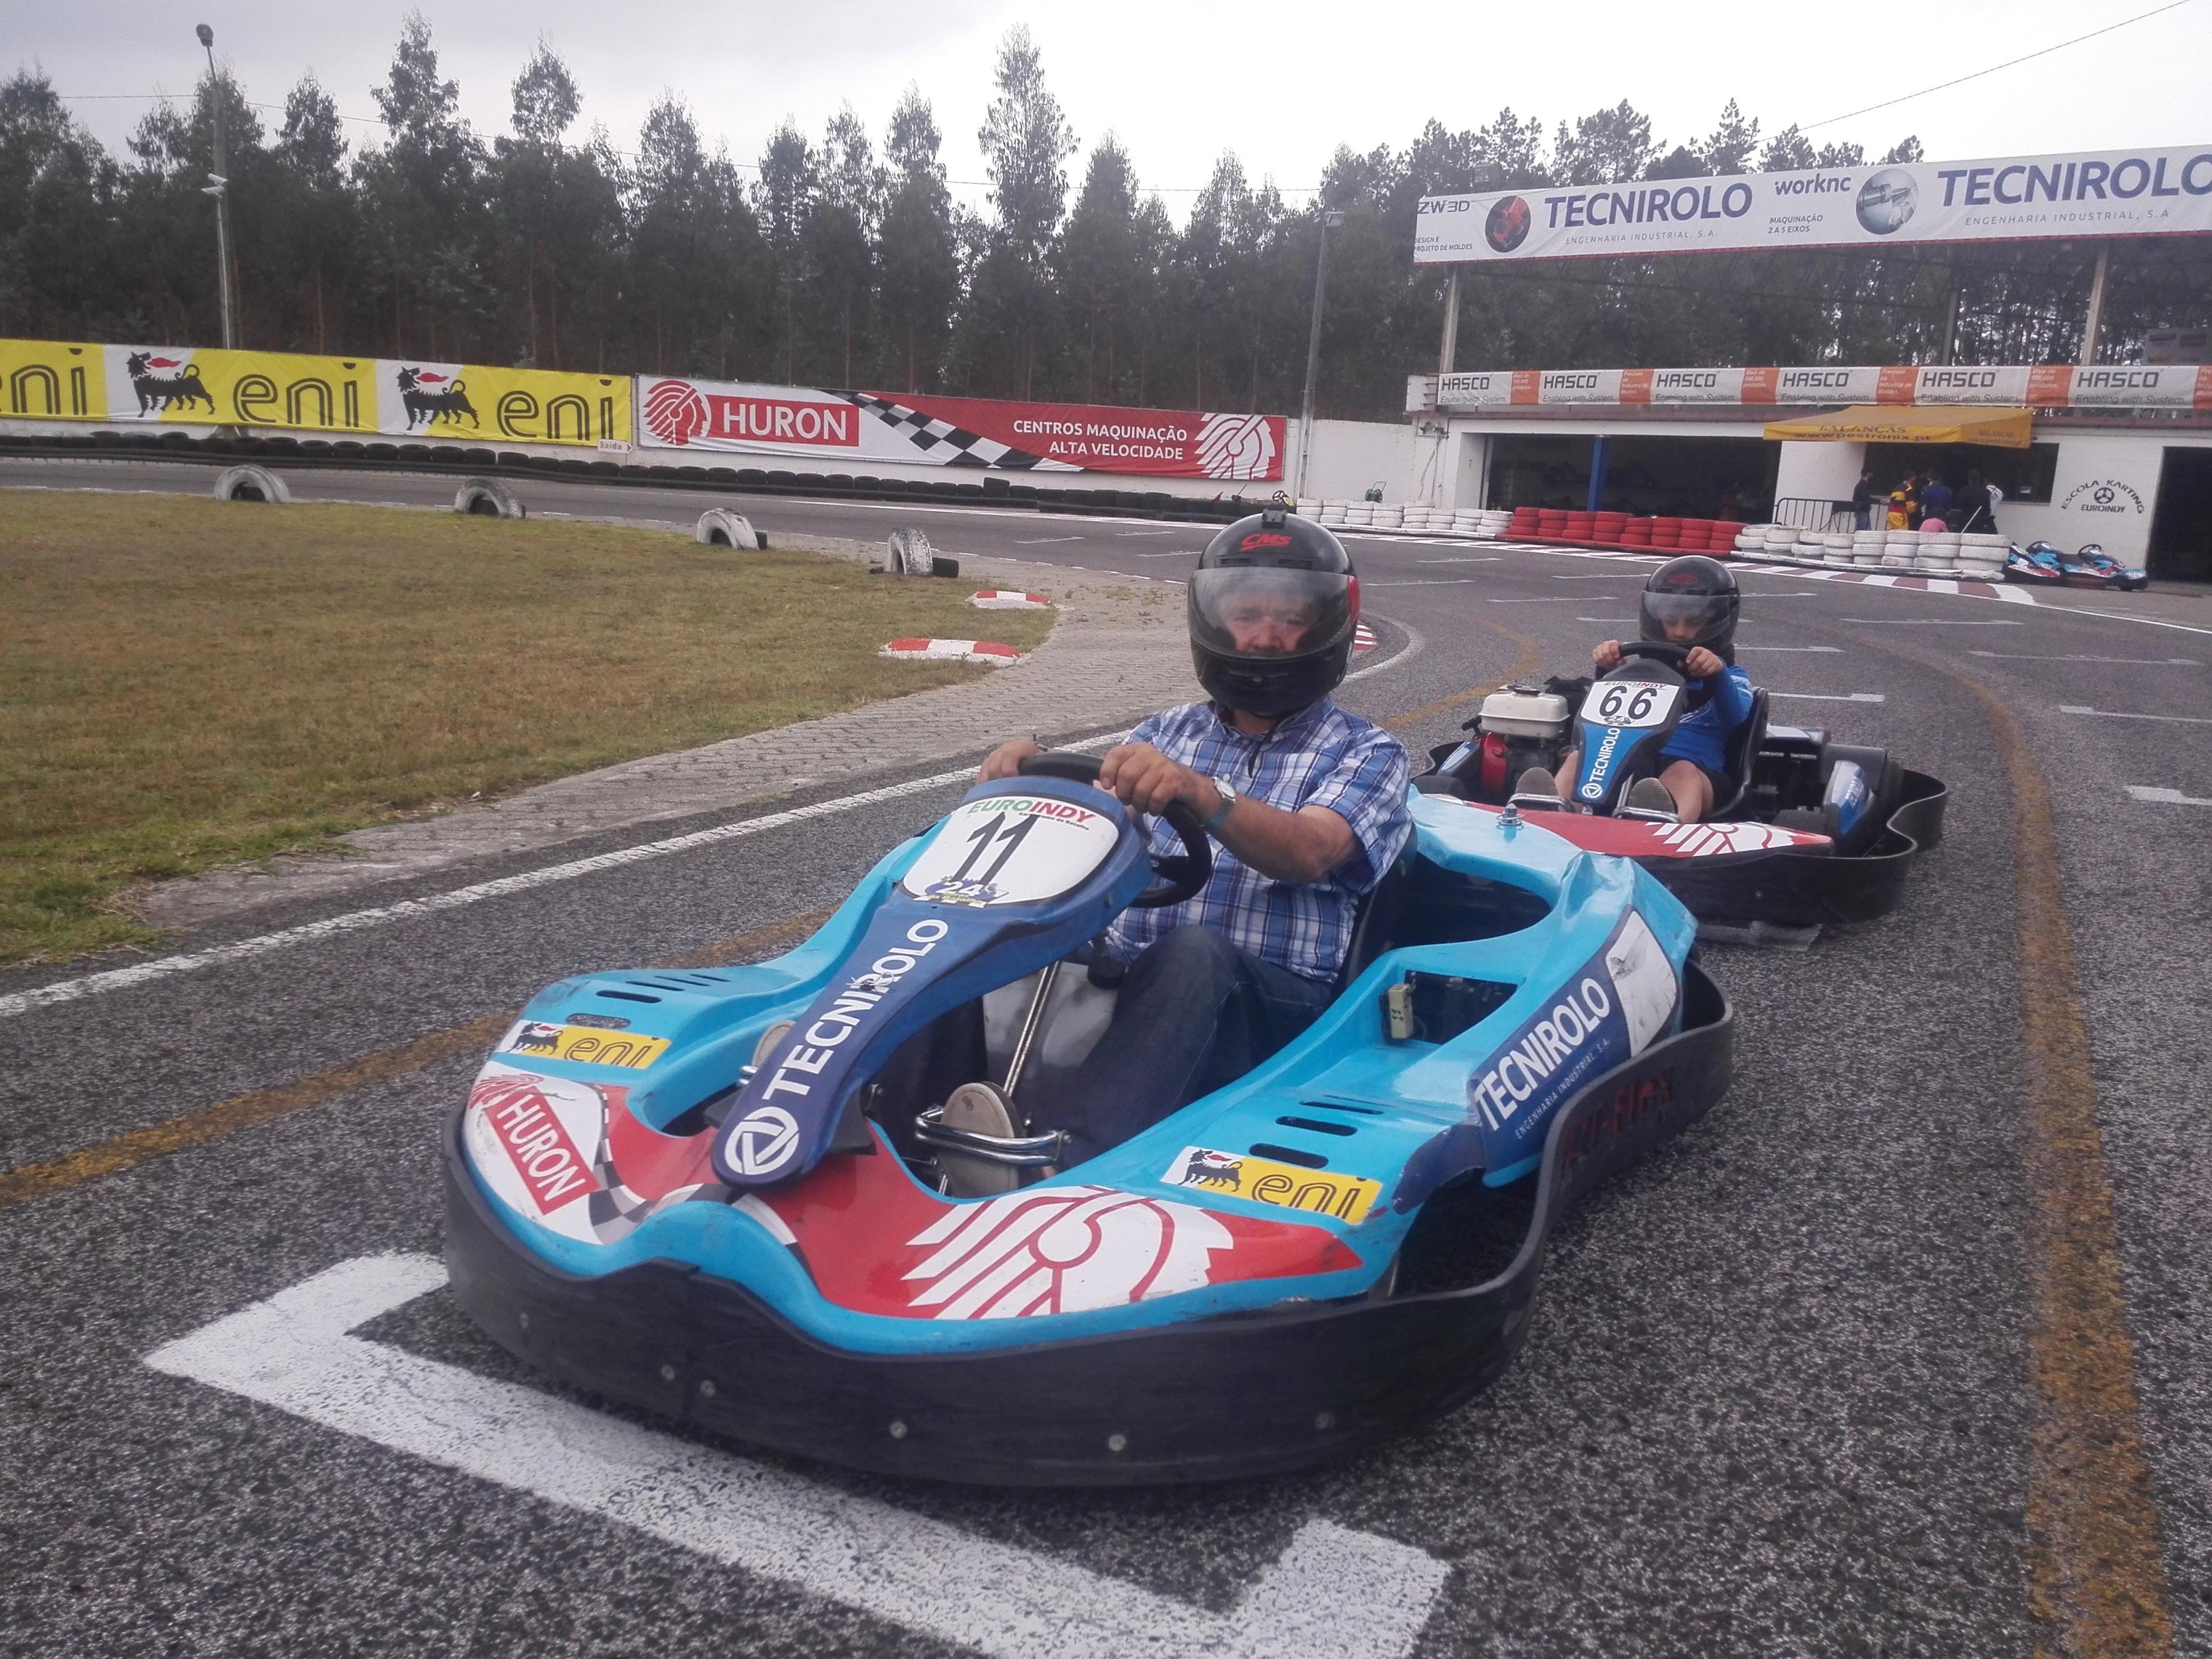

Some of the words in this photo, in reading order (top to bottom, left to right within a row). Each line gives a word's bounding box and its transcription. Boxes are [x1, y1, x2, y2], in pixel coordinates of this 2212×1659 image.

[1775, 173, 1851, 195] worknc
[1937, 154, 2212, 207] TECNIROLO
[1417, 200, 1470, 214] ZW3D
[1545, 182, 1753, 228] TECNIROLO
[1769, 213, 1823, 225] MAQUINAÇÃO
[1965, 215, 2046, 226] ENGENHARIA
[2054, 211, 2140, 222] INDUSTRIAL,
[1565, 234, 1626, 245] ENGENHARIA
[1631, 231, 1693, 241] INDUSTRIAL,
[0, 348, 87, 415] ni
[1442, 377, 1490, 391] HASCO
[1543, 375, 1597, 389] HASCO
[1656, 374, 1717, 387] HASCO
[1783, 372, 1850, 387] HASCO
[1922, 372, 1996, 387] HASCO
[2076, 372, 2159, 387] HASCO
[233, 362, 359, 427] eni
[1543, 394, 1570, 403] Enabling
[1656, 393, 1687, 402] Enabling
[1781, 393, 1817, 402] Enabling
[1920, 393, 1960, 403] Enabling
[2075, 395, 2118, 405] Enabling
[497, 379, 613, 441] eni
[723, 402, 846, 441] HURON
[1014, 420, 1082, 435] CENTROS
[1087, 423, 1187, 443] MAQUINAÇÃO
[1049, 441, 1087, 455] ALTA
[1091, 443, 1184, 460] VELOCIDADE
[2061, 480, 2100, 510] ESCOLA
[2106, 479, 2144, 514] KARTING
[2081, 504, 2126, 513] EUROINDY
[1599, 685, 1658, 719] 66
[1589, 728, 1620, 782] TECNIROLO
[967, 799, 1096, 822] EUROINDY
[950, 812, 1041, 885] 11
[762, 919, 948, 1100] TECNIROLO
[564, 1036, 660, 1067] eni
[1474, 978, 1610, 1131] TECNIROLO
[1515, 1091, 1559, 1139] ENGENHARIA
[496, 1095, 587, 1202] HURON
[1252, 1174, 1367, 1220] eni
